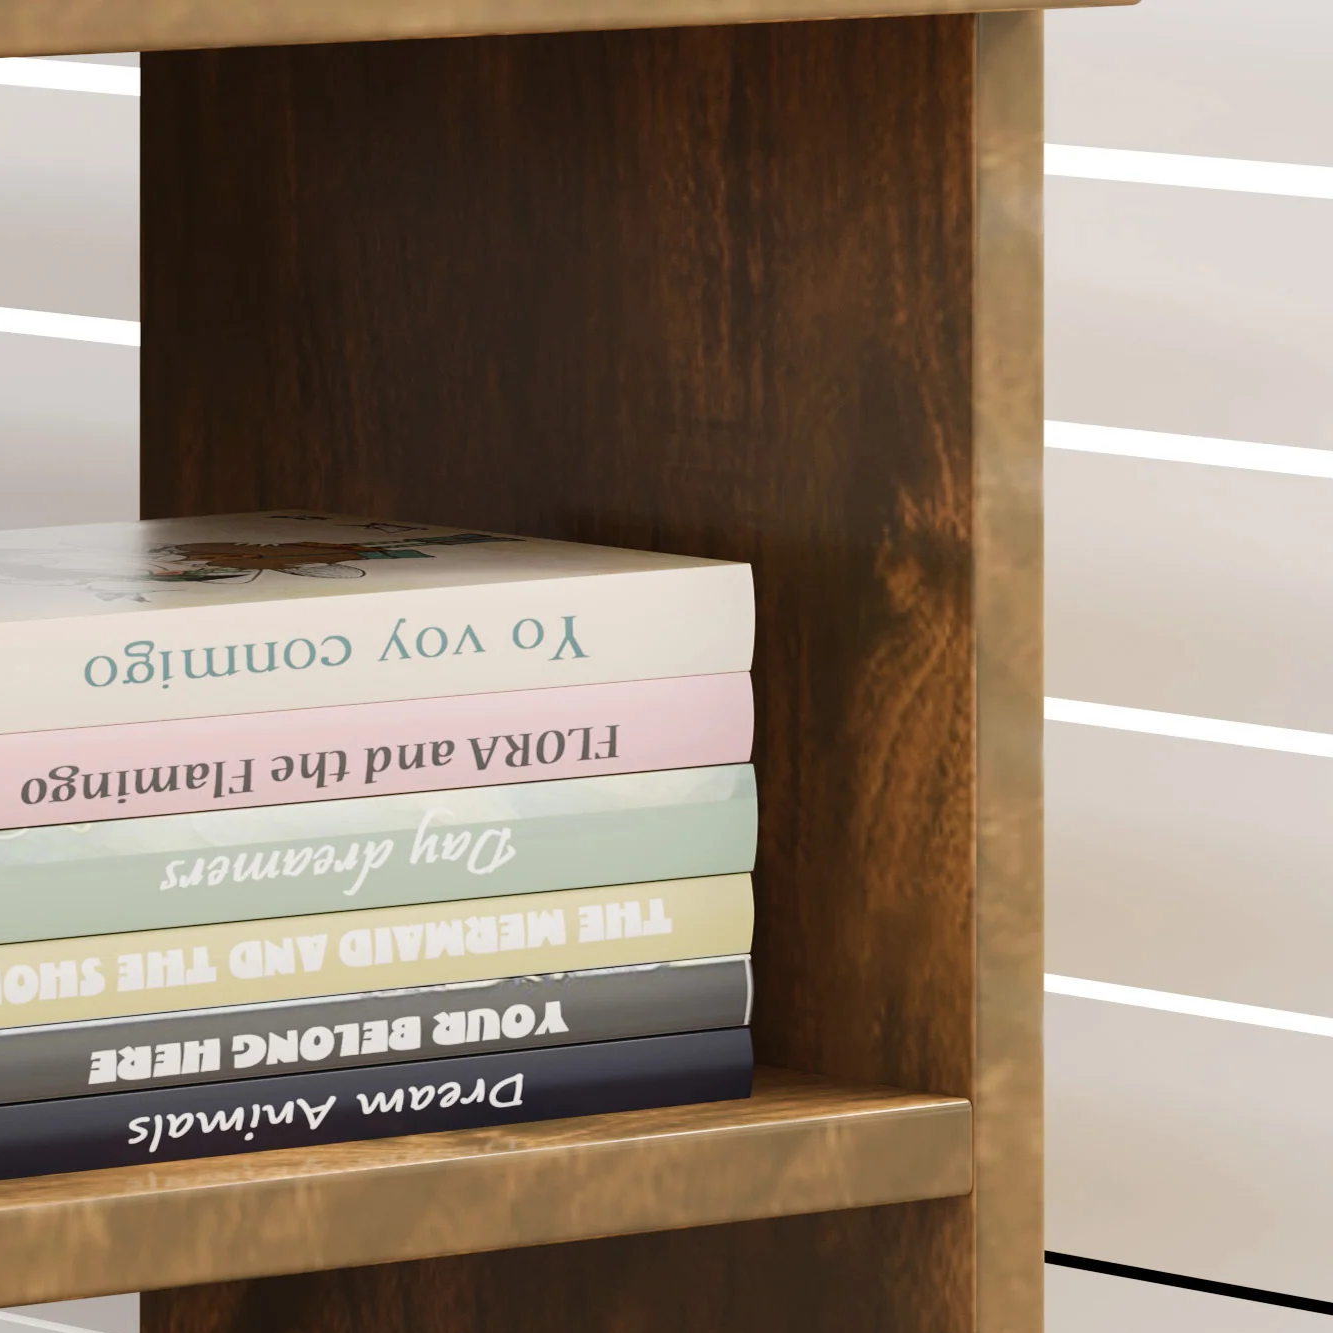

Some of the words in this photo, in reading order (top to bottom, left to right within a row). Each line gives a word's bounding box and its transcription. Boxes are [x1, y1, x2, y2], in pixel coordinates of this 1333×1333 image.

[84, 634, 353, 689] conmigo
[378, 617, 486, 662] voy
[512, 615, 590, 661] Yo
[270, 750, 350, 789] the
[364, 740, 455, 785] and
[467, 724, 620, 772] FLORA
[20, 758, 257, 805] Flamingo
[409, 808, 516, 875] Day
[159, 837, 395, 896] dreamers
[338, 908, 567, 967] MERMAID
[578, 897, 673, 943] THE
[116, 946, 218, 992] THE
[228, 933, 329, 981] AND
[231, 1015, 422, 1070] BELONG
[433, 1001, 569, 1047] YOUR
[88, 1038, 221, 1085] HERE
[356, 1072, 525, 1116] Dream
[127, 1094, 337, 1153] Animals
